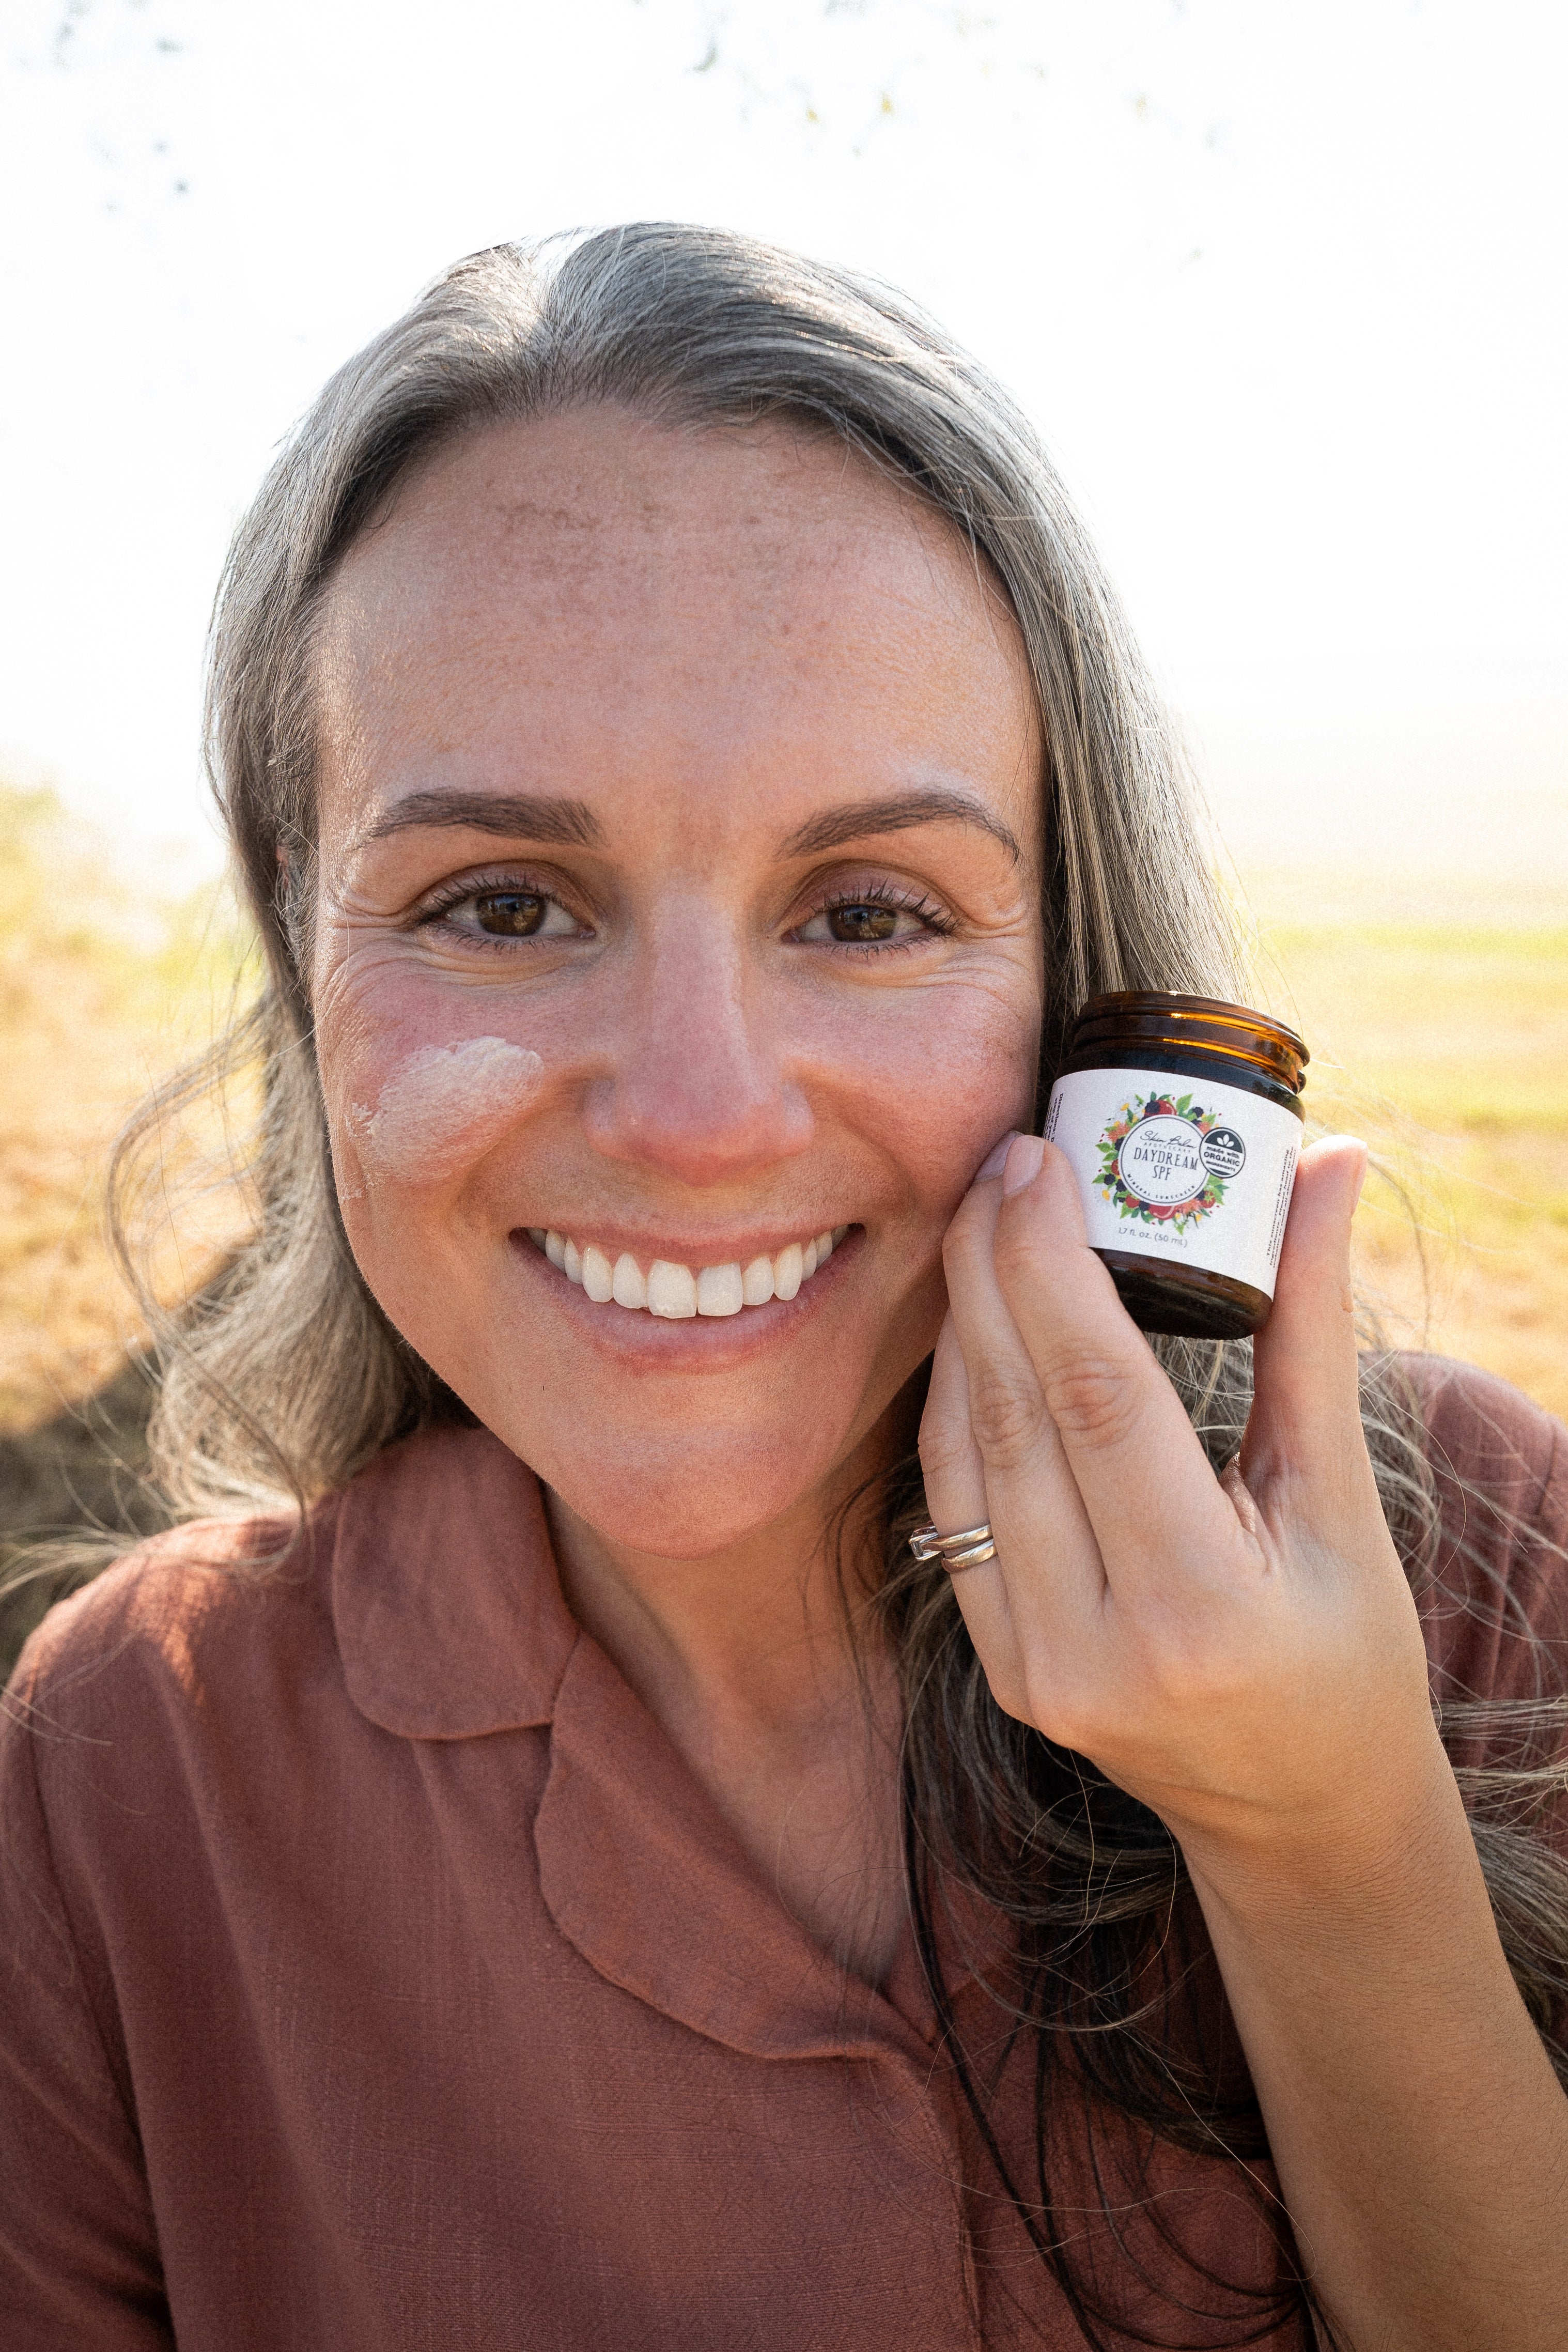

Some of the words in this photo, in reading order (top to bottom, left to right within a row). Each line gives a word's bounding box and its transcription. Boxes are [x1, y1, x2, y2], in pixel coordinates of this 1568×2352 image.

[1052, 1093, 1063, 1135] Directions:
[1140, 1130, 1167, 1142] Skin
[1144, 1142, 1191, 1153] APOTHECARY
[1134, 1147, 1199, 1170] DAYDREAM
[1204, 1151, 1240, 1167] ORGANIC
[1153, 1165, 1172, 1181] SPF
[1127, 1173, 1151, 1196] MINERAL
[1156, 1185, 1194, 1199] SUNSCREEN
[1271, 1199, 1279, 1237] sunscreen
[1154, 1232, 1169, 1242] (50
